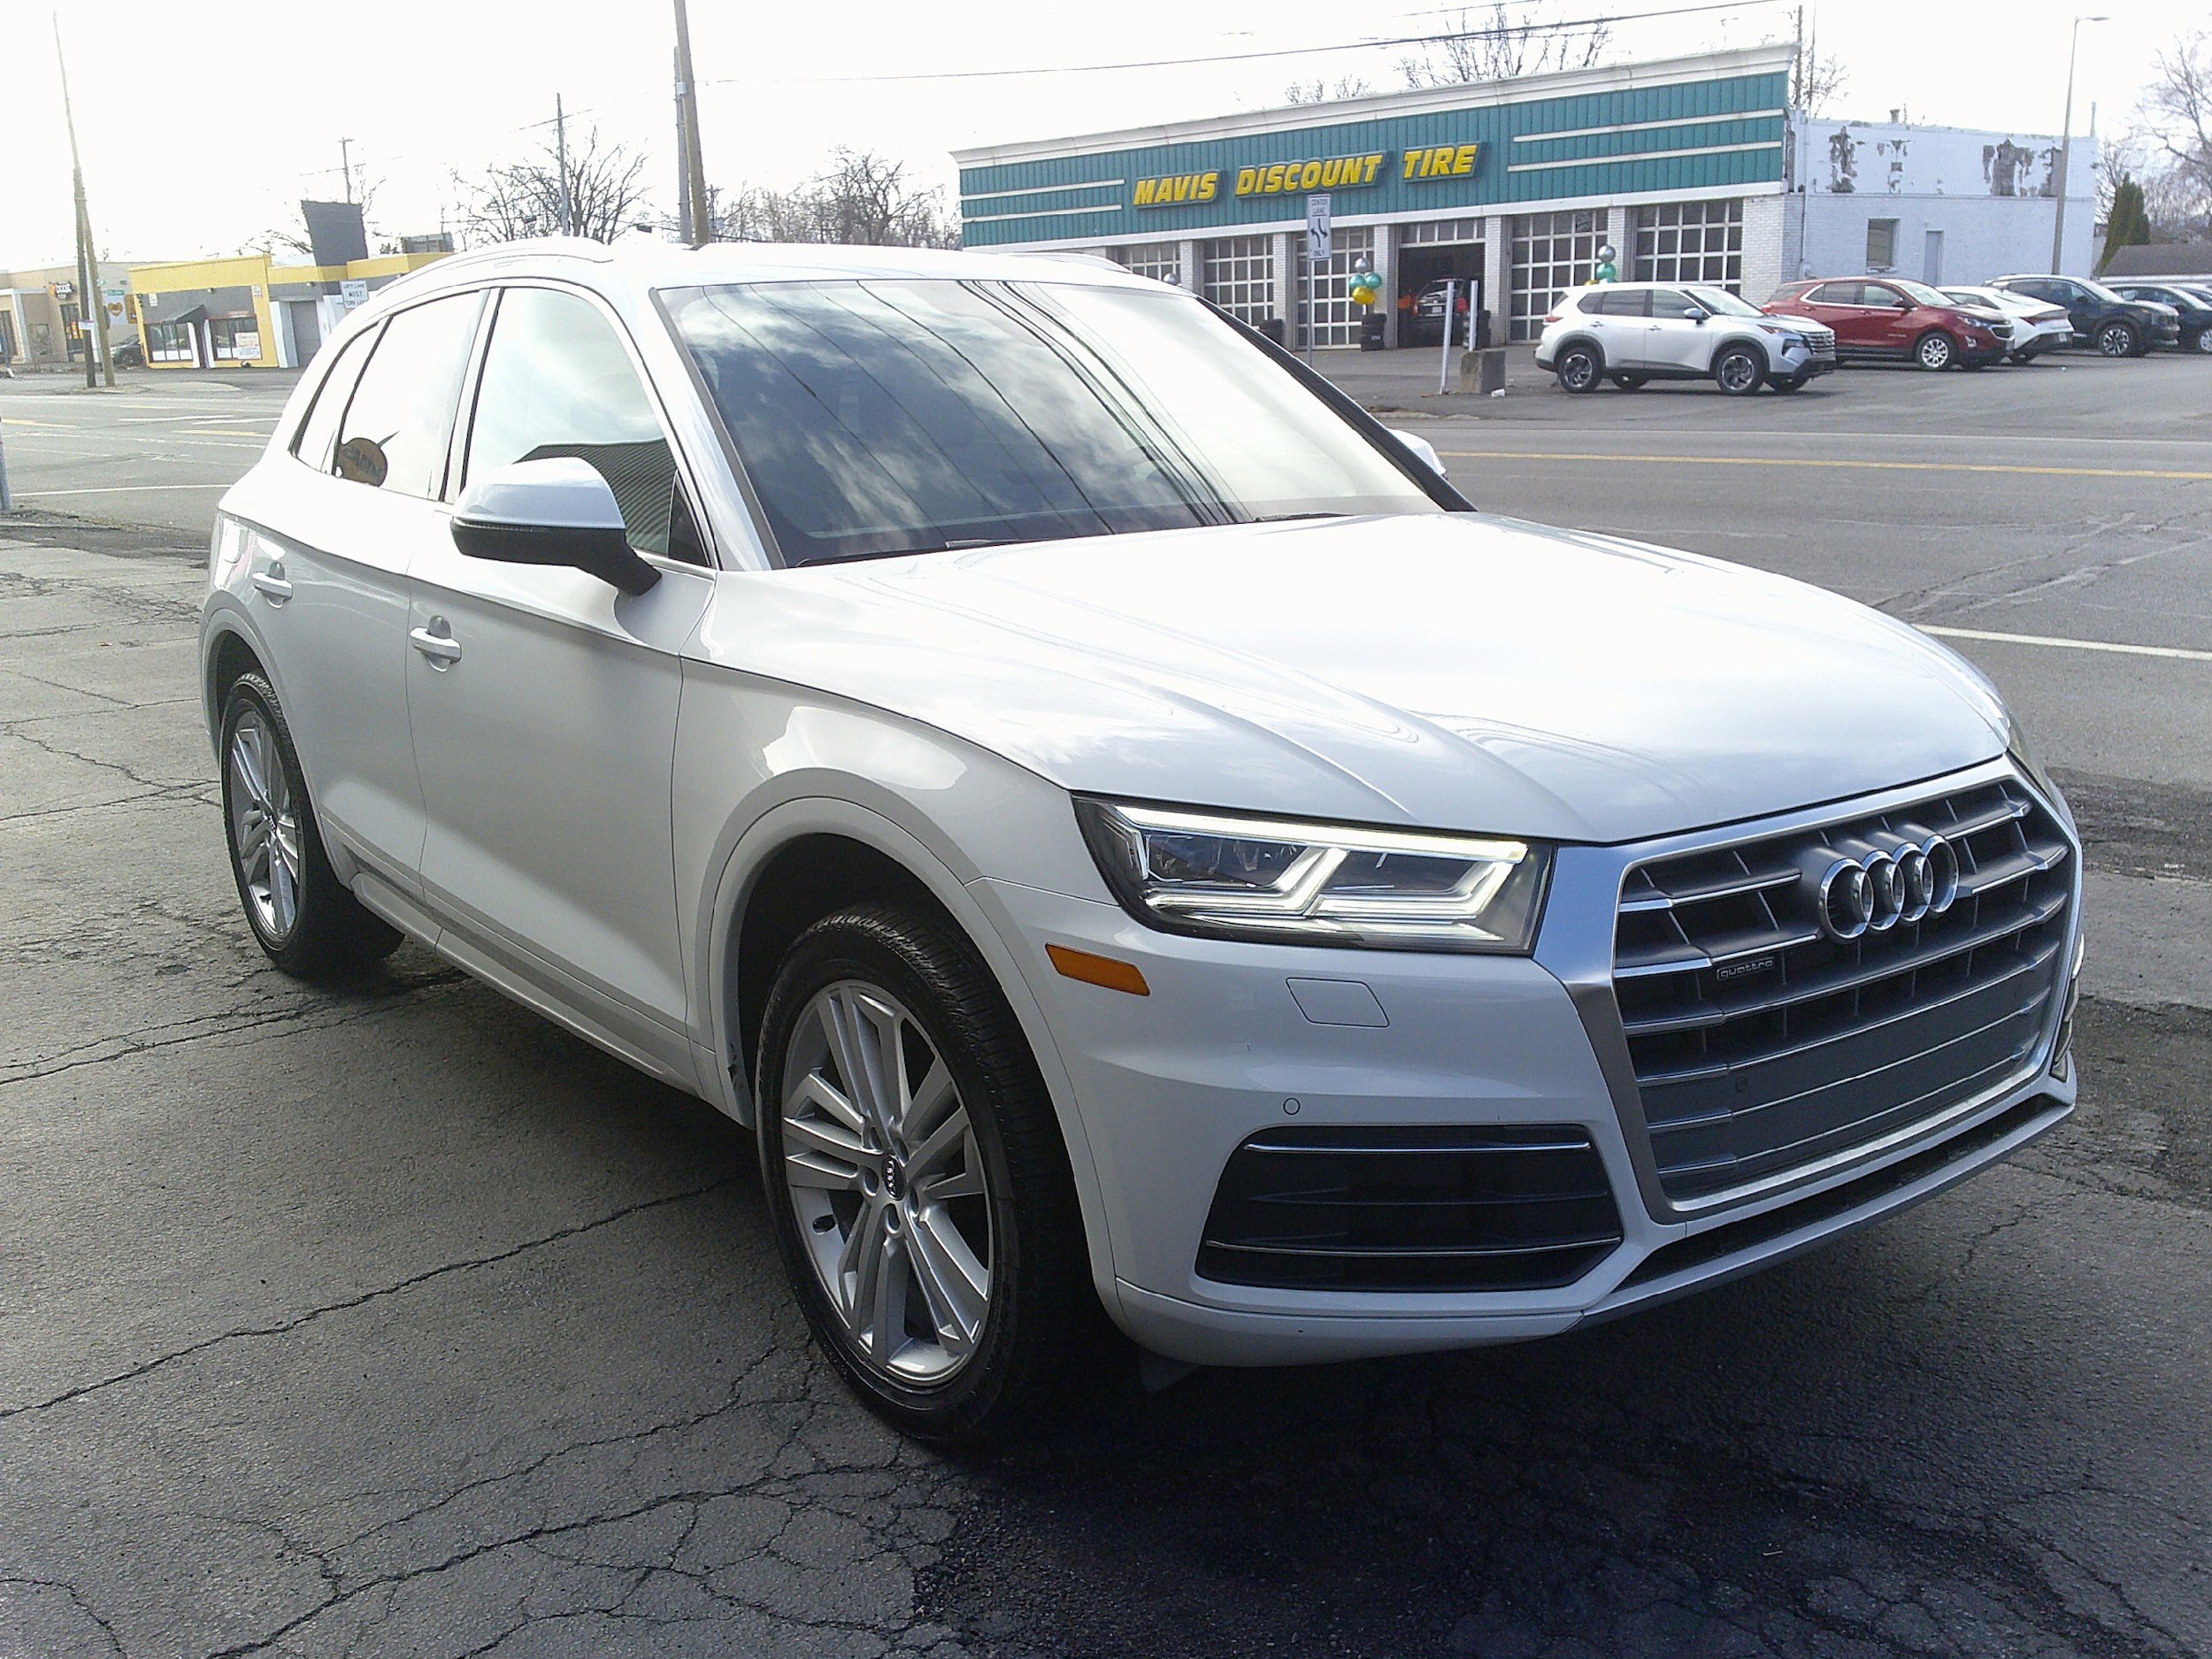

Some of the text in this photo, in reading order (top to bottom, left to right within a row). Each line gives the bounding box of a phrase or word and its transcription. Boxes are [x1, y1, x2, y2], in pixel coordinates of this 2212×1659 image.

[1133, 144, 1479, 205] MAVIS DISCOUNT TIRE
[1720, 960, 1773, 978] quattro
